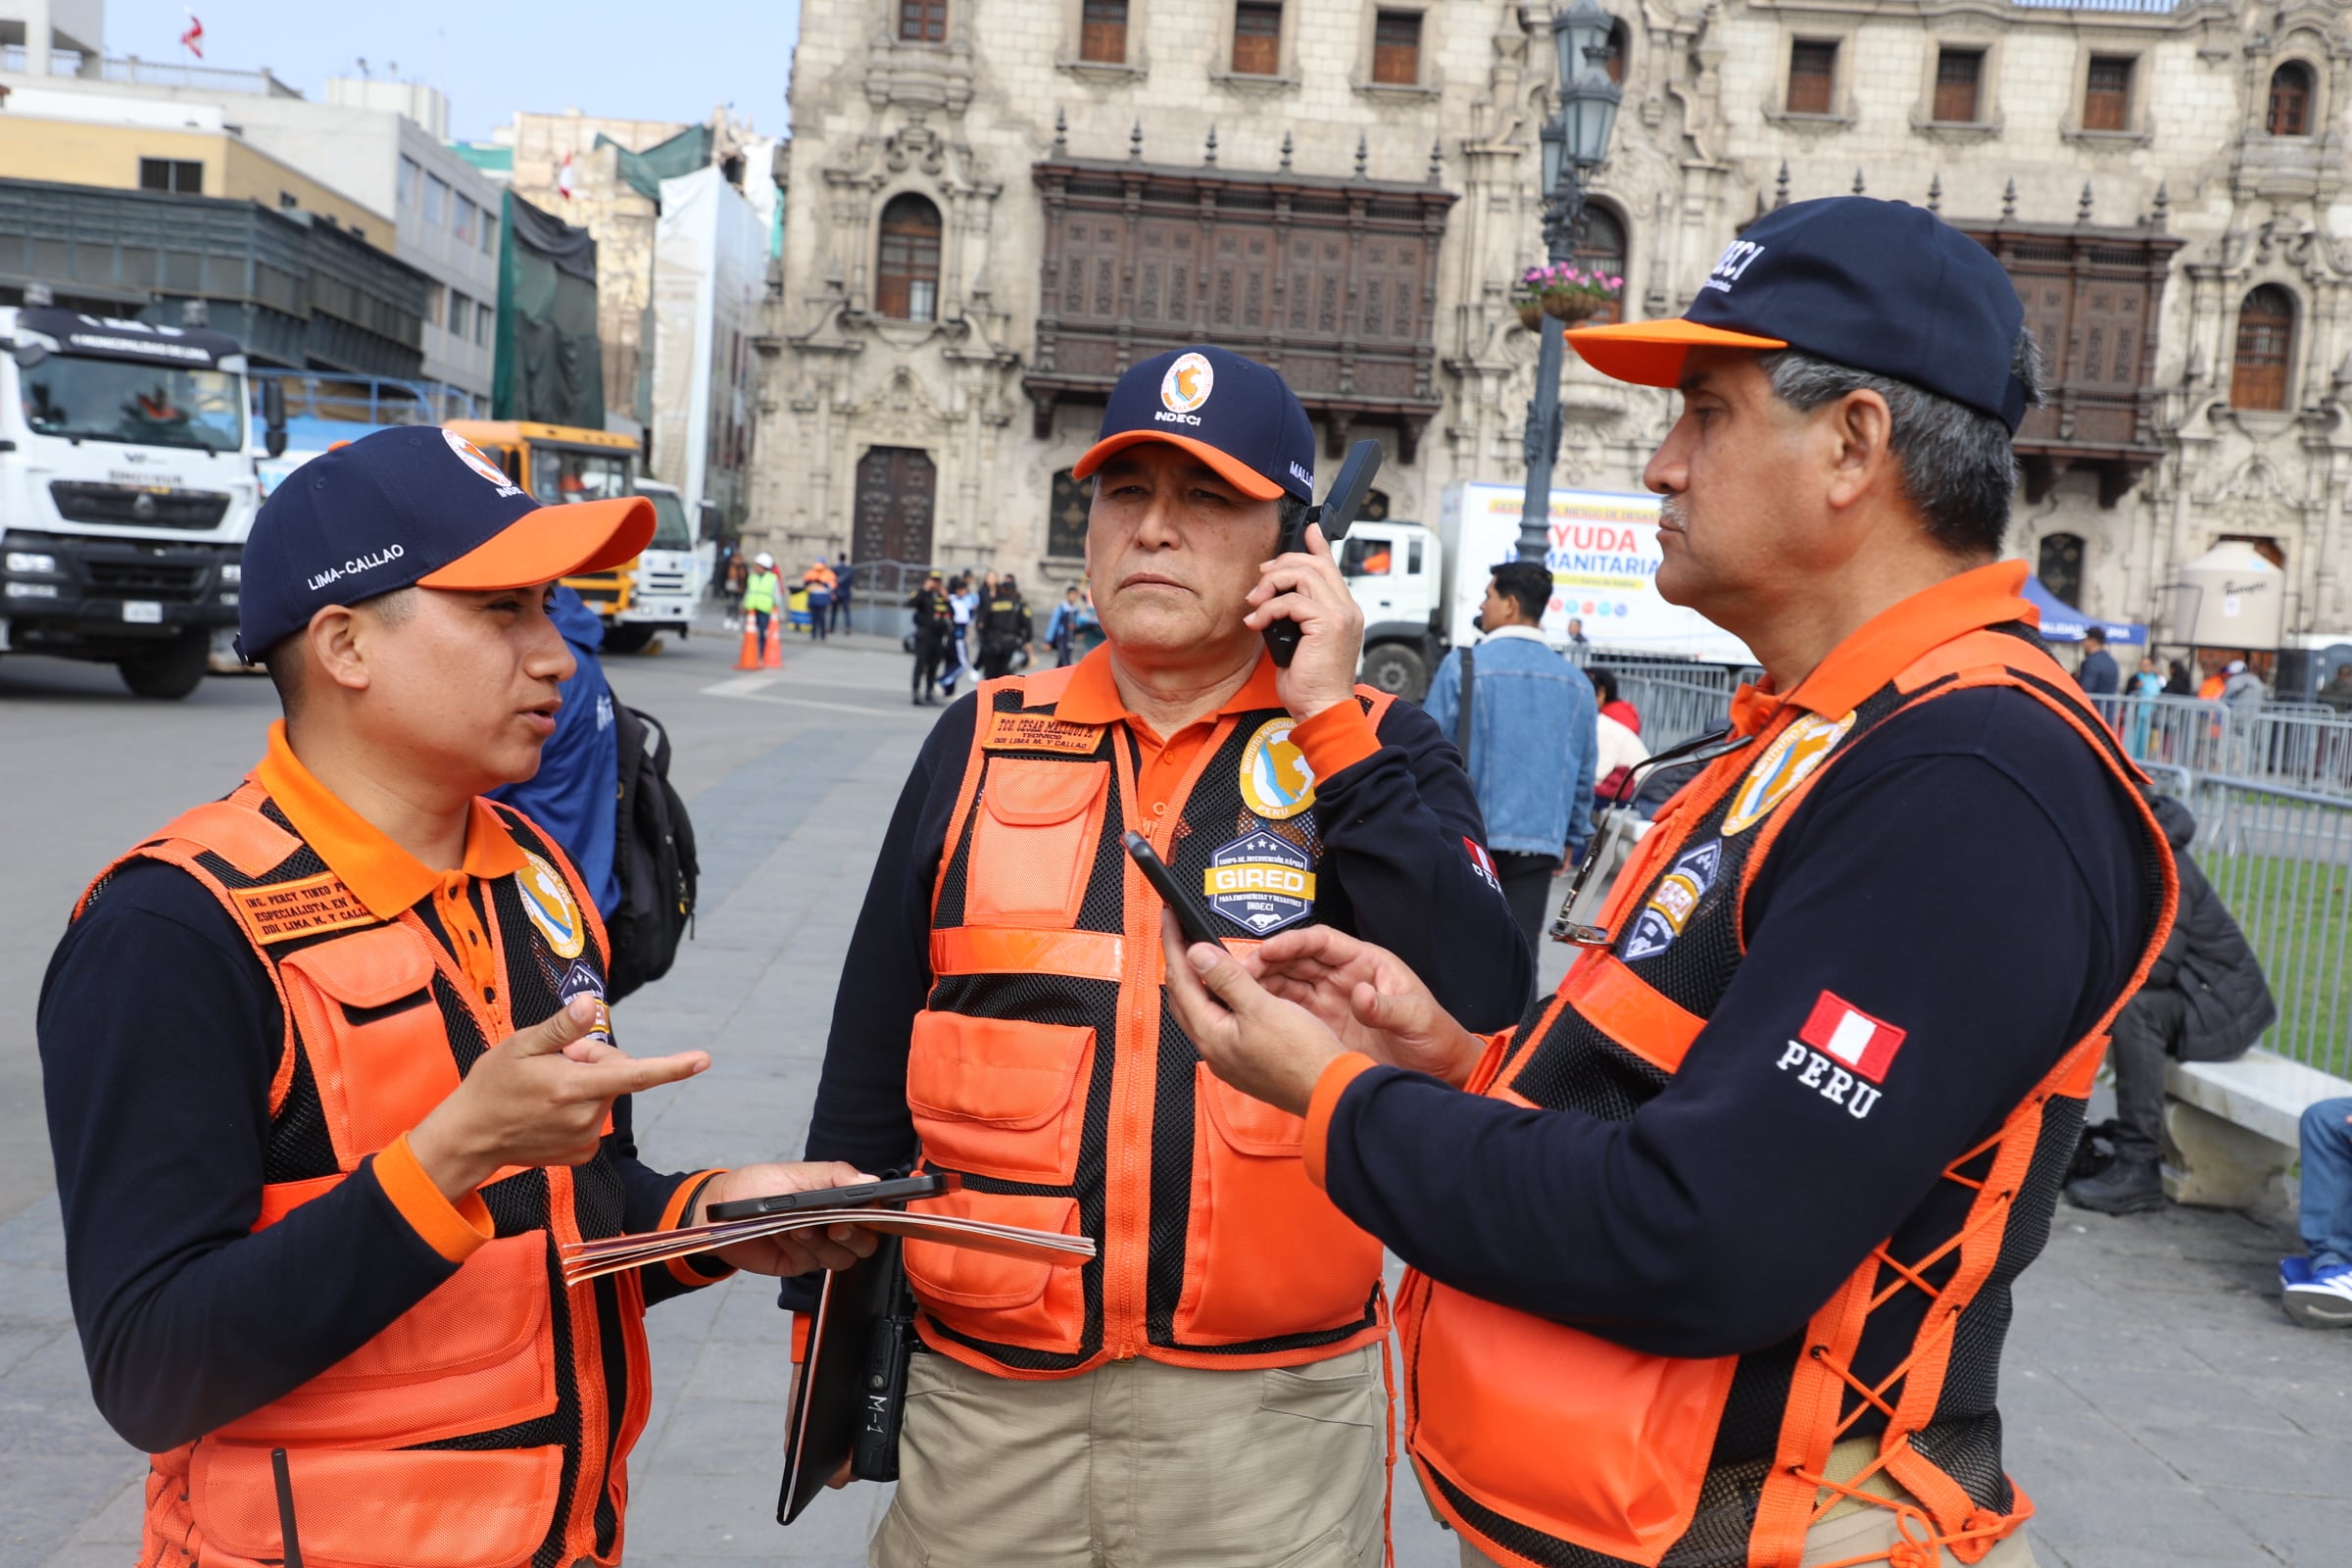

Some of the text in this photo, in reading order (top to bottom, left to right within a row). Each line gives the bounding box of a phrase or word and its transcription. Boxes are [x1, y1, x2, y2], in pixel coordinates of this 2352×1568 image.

[1154, 411, 1201, 426] INDECI
[1546, 522, 1638, 554] YUDA
[307, 544, 405, 591] LIMA-CALLAO
[1054, 740, 1088, 749] CALLAO
[1242, 735, 1263, 774] INSTITUTO
[1215, 868, 1304, 893] GIRED
[245, 897, 268, 908] ING.
[268, 892, 299, 906] PERCY
[300, 885, 331, 899] TINEO
[330, 897, 349, 909] EN
[1247, 901, 1274, 911] INDECI
[282, 918, 313, 931] LIMA
[327, 912, 337, 922] Y
[1776, 1040, 1883, 1119] PERU
[866, 1395, 888, 1434] M-1
